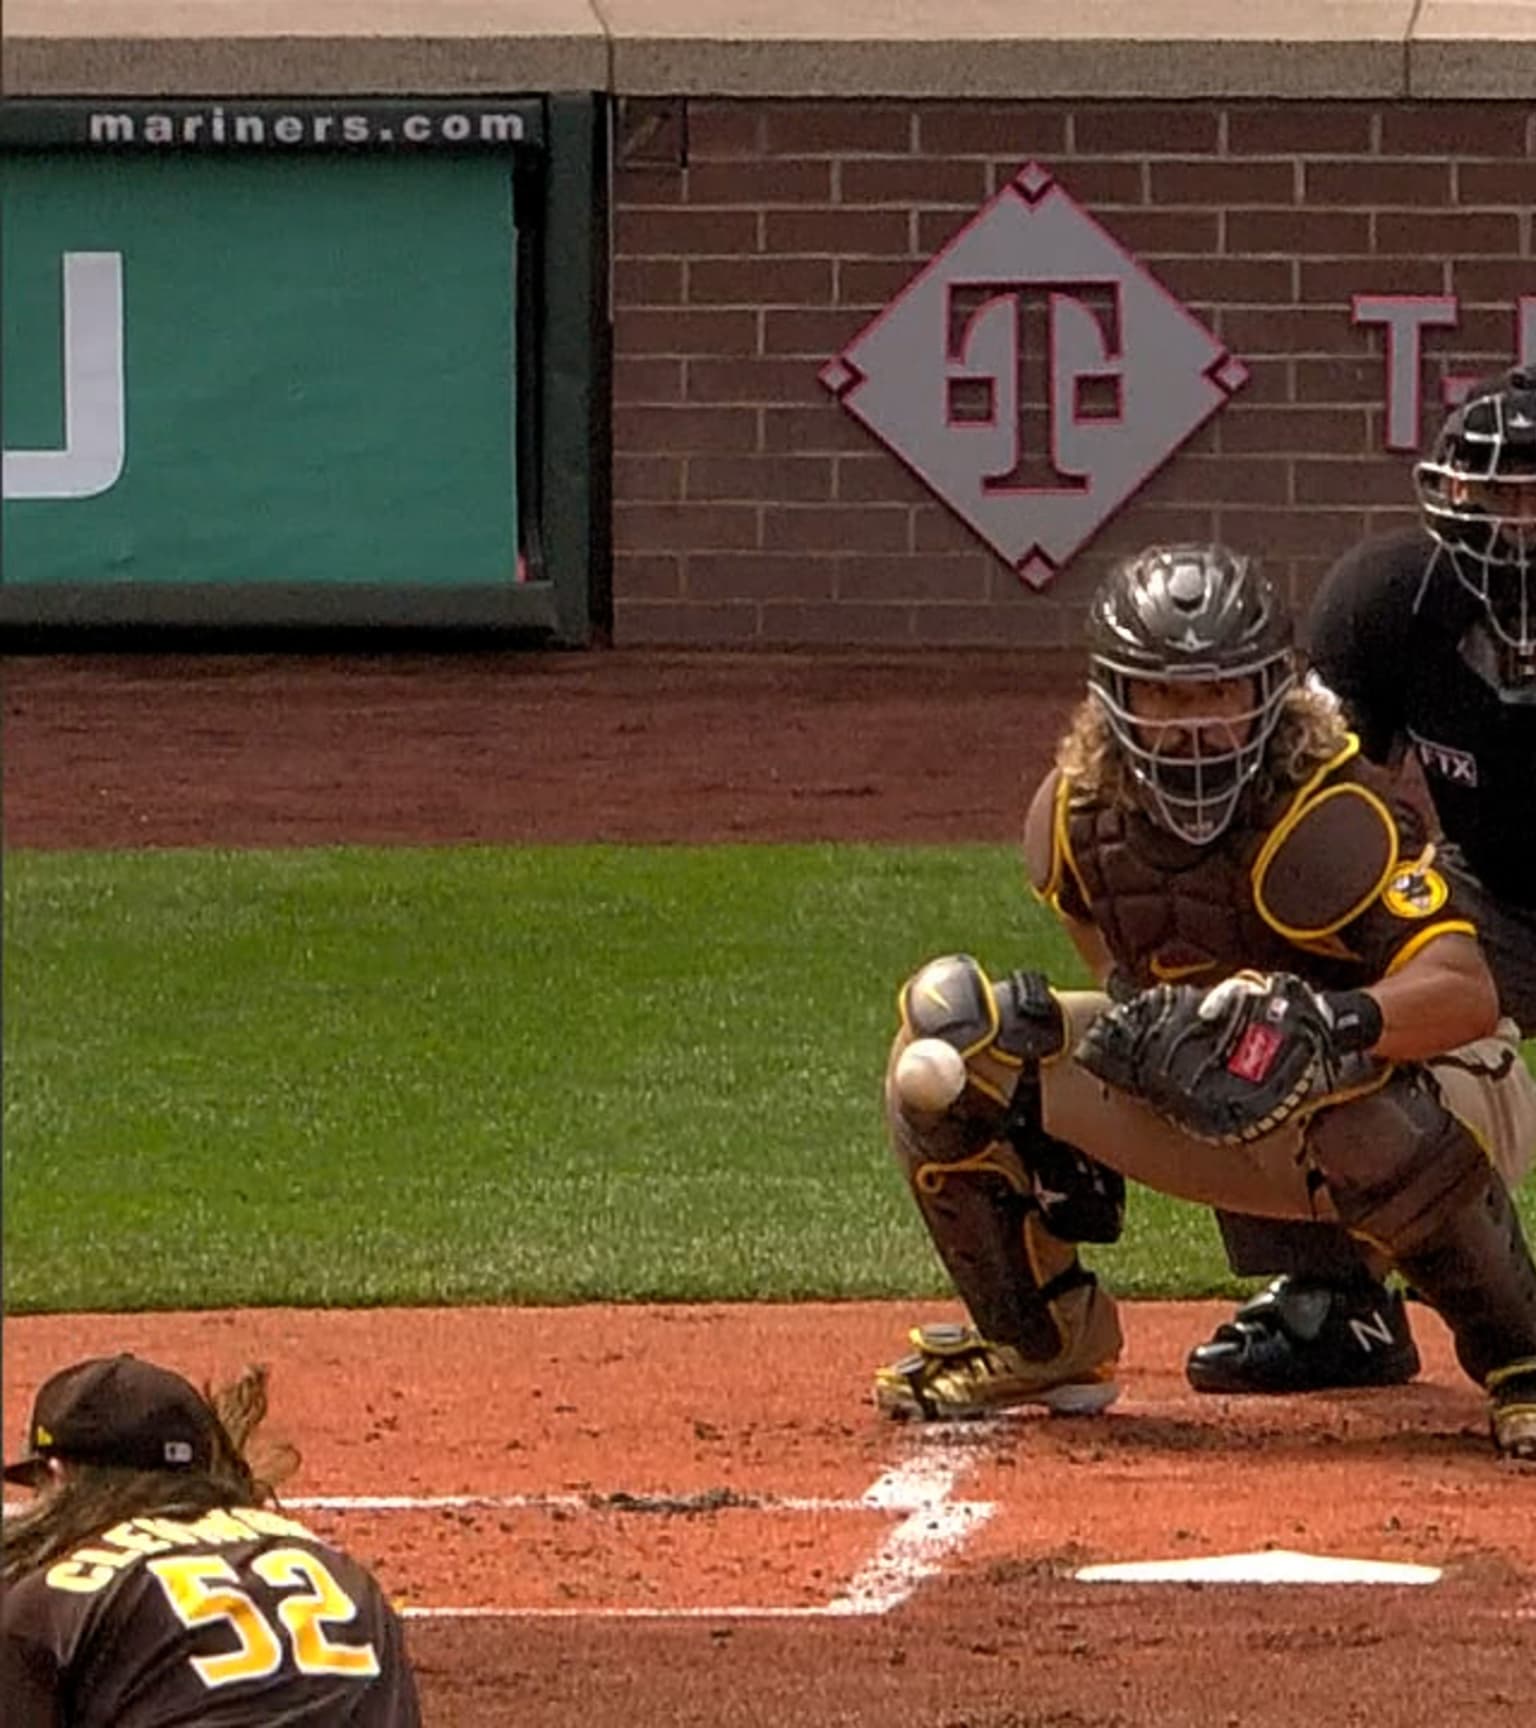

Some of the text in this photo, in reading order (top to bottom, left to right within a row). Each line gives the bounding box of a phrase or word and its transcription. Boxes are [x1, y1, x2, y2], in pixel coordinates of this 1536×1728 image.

[90, 107, 526, 142] mariners.com
[946, 280, 1123, 497] T
[1349, 1310, 1393, 1352] N
[147, 1547, 381, 1689] 52
